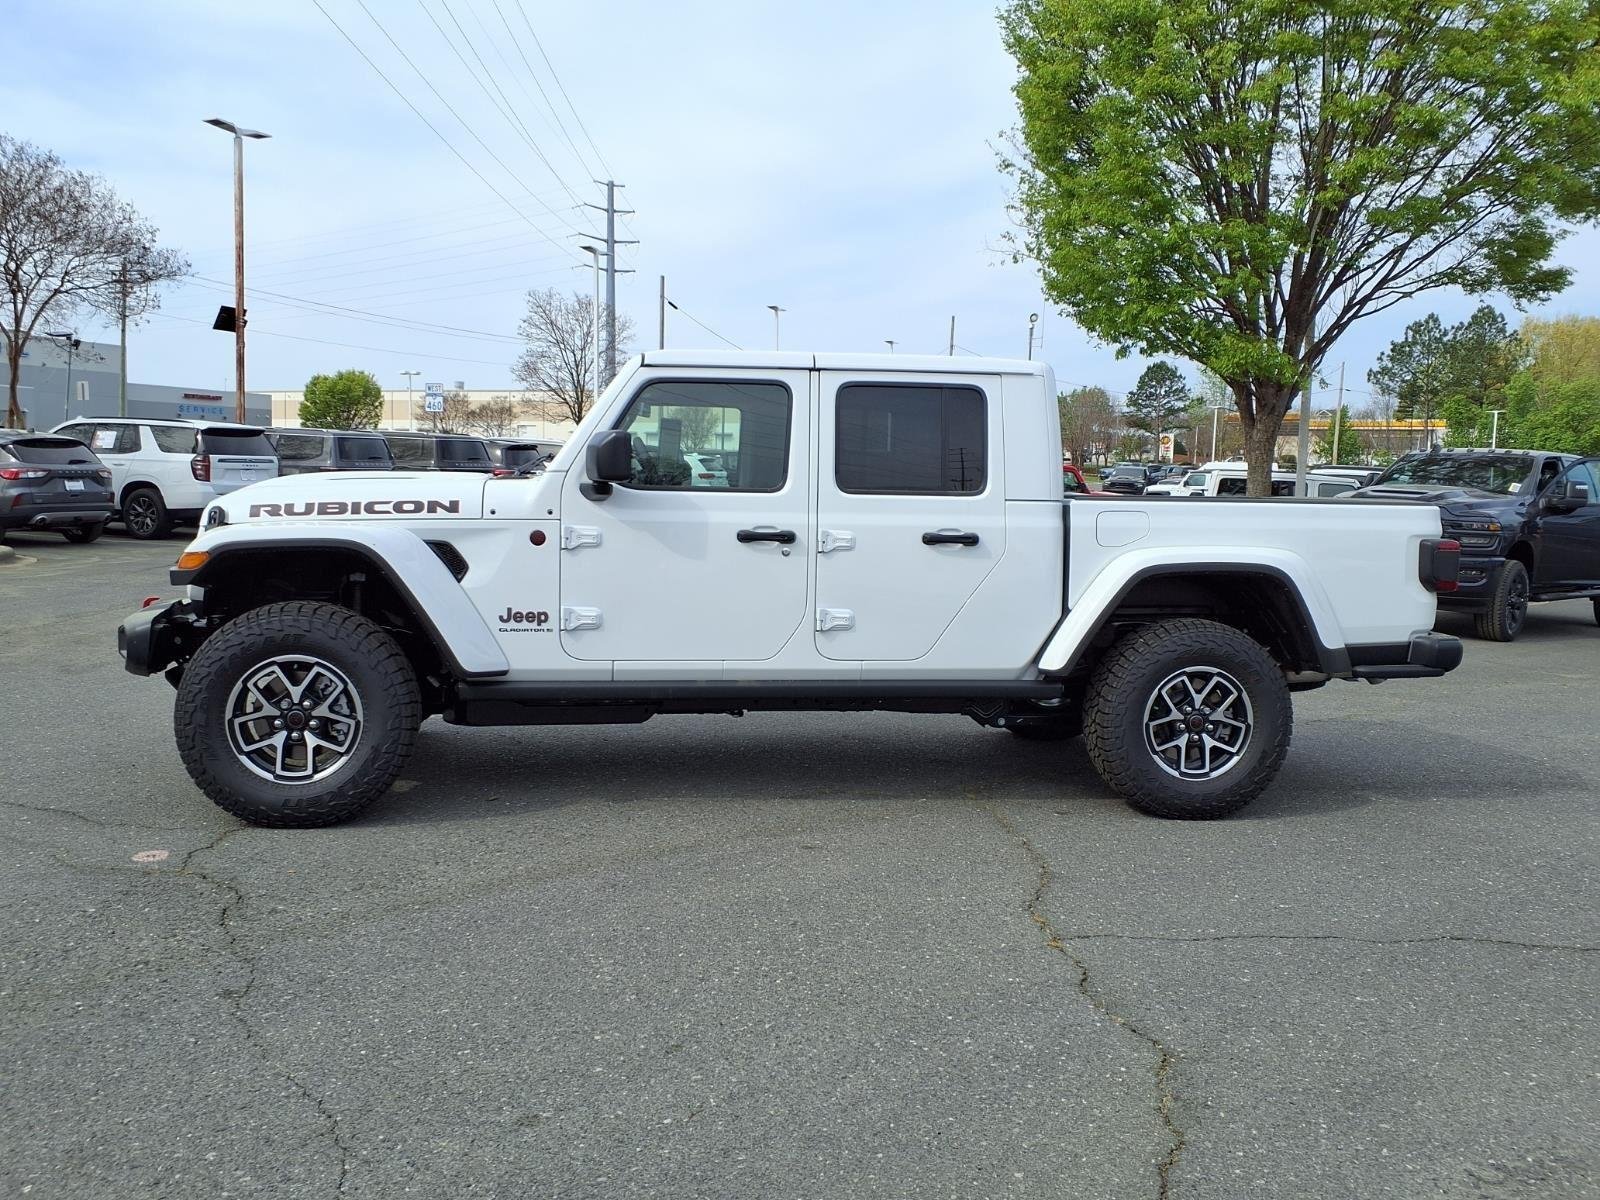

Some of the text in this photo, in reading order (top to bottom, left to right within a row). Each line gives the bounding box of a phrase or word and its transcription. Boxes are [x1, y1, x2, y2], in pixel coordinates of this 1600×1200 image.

[178, 404, 223, 414] SERVICE
[427, 401, 442, 410] 460
[249, 499, 460, 518] RUBICON
[498, 607, 549, 626] Jeep
